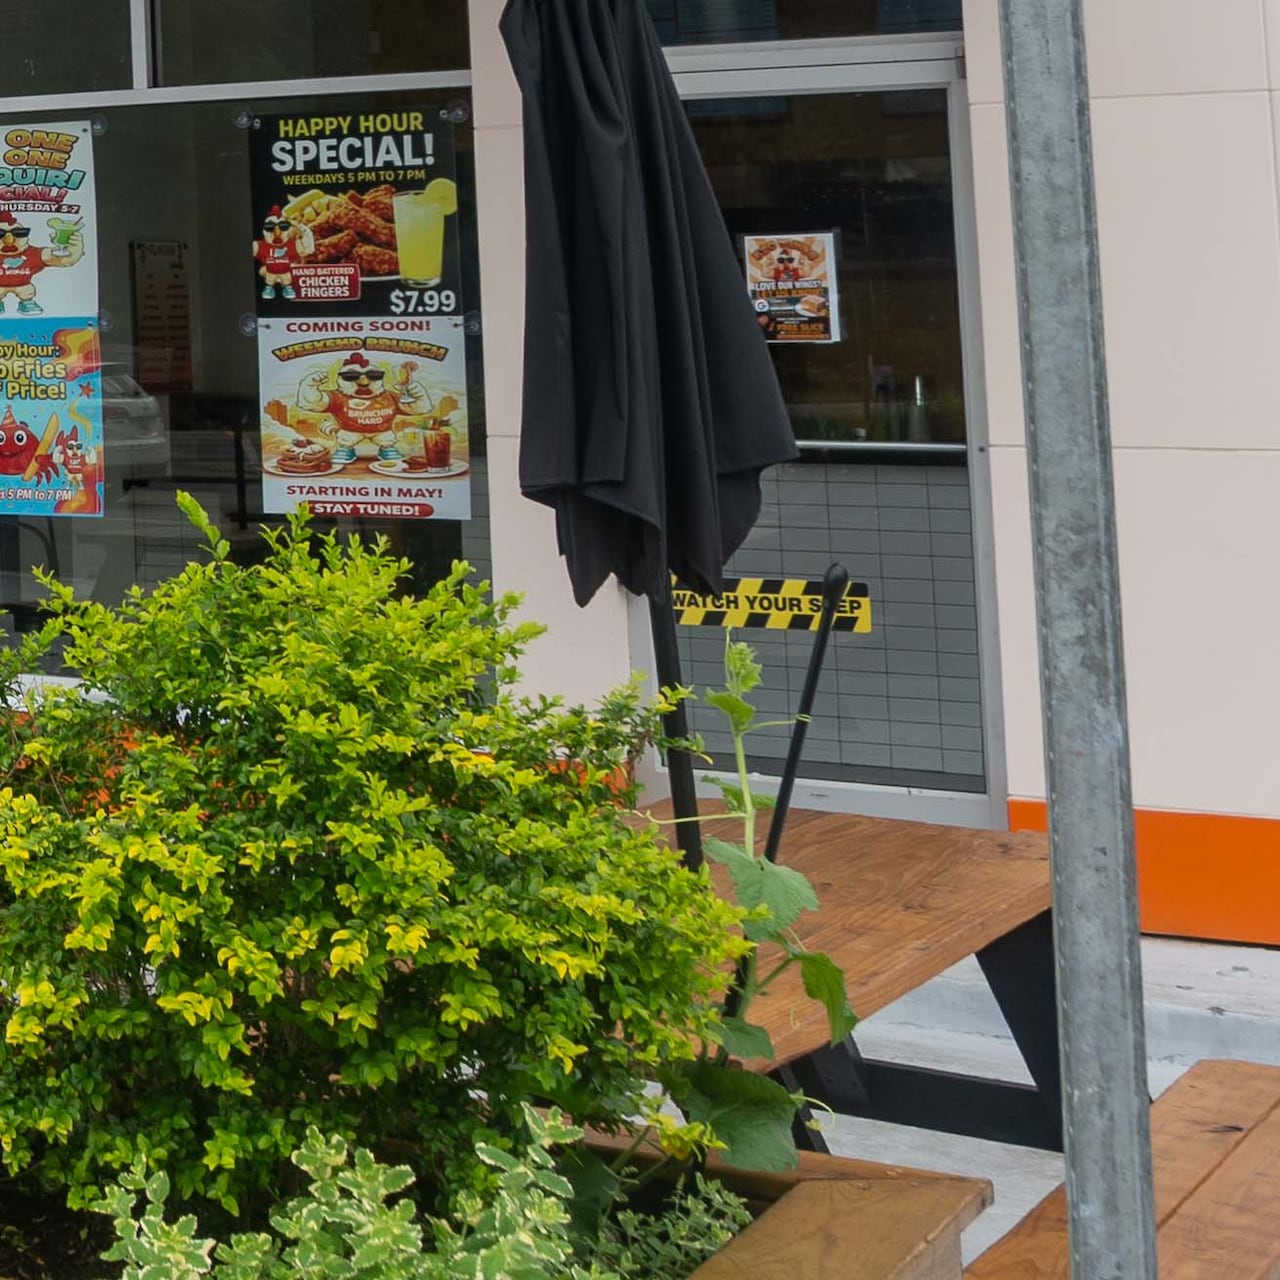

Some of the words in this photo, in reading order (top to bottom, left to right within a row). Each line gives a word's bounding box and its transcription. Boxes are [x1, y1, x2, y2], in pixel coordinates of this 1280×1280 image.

[279, 116, 353, 138] HAPPY
[359, 112, 424, 134] HOUR
[5, 129, 79, 152] ONE
[3, 149, 71, 170] ONE
[271, 133, 435, 172] SPECIAL!
[283, 172, 345, 186] WEEKDAYS
[348, 172, 355, 183] 5
[358, 171, 376, 183] PM
[380, 170, 395, 181] TO
[398, 170, 404, 181] 7
[407, 169, 426, 180] PM
[60, 205, 80, 214] 5-7
[299, 276, 349, 287] CHICKEN
[301, 287, 350, 298] FINGERS
[390, 289, 456, 315] $7.99
[286, 321, 364, 332] COMING
[369, 320, 431, 332] SOON!
[16, 344, 60, 358] Hour:
[272, 337, 365, 362] WEEKEND
[364, 337, 449, 362] BRUNCH
[12, 360, 67, 380] Fries
[6, 381, 67, 399] Price!
[7, 488, 14, 500] 5
[16, 488, 32, 500] PM
[35, 489, 45, 500] to
[47, 489, 55, 500] 7
[56, 489, 72, 501] PM
[287, 485, 369, 497] STARTING
[375, 486, 390, 497] IN
[397, 487, 443, 499] MAY!
[315, 502, 358, 515] STAY
[359, 503, 420, 516] TUNED!
[745, 595, 801, 612] YOUR
[809, 598, 861, 614] SEP
